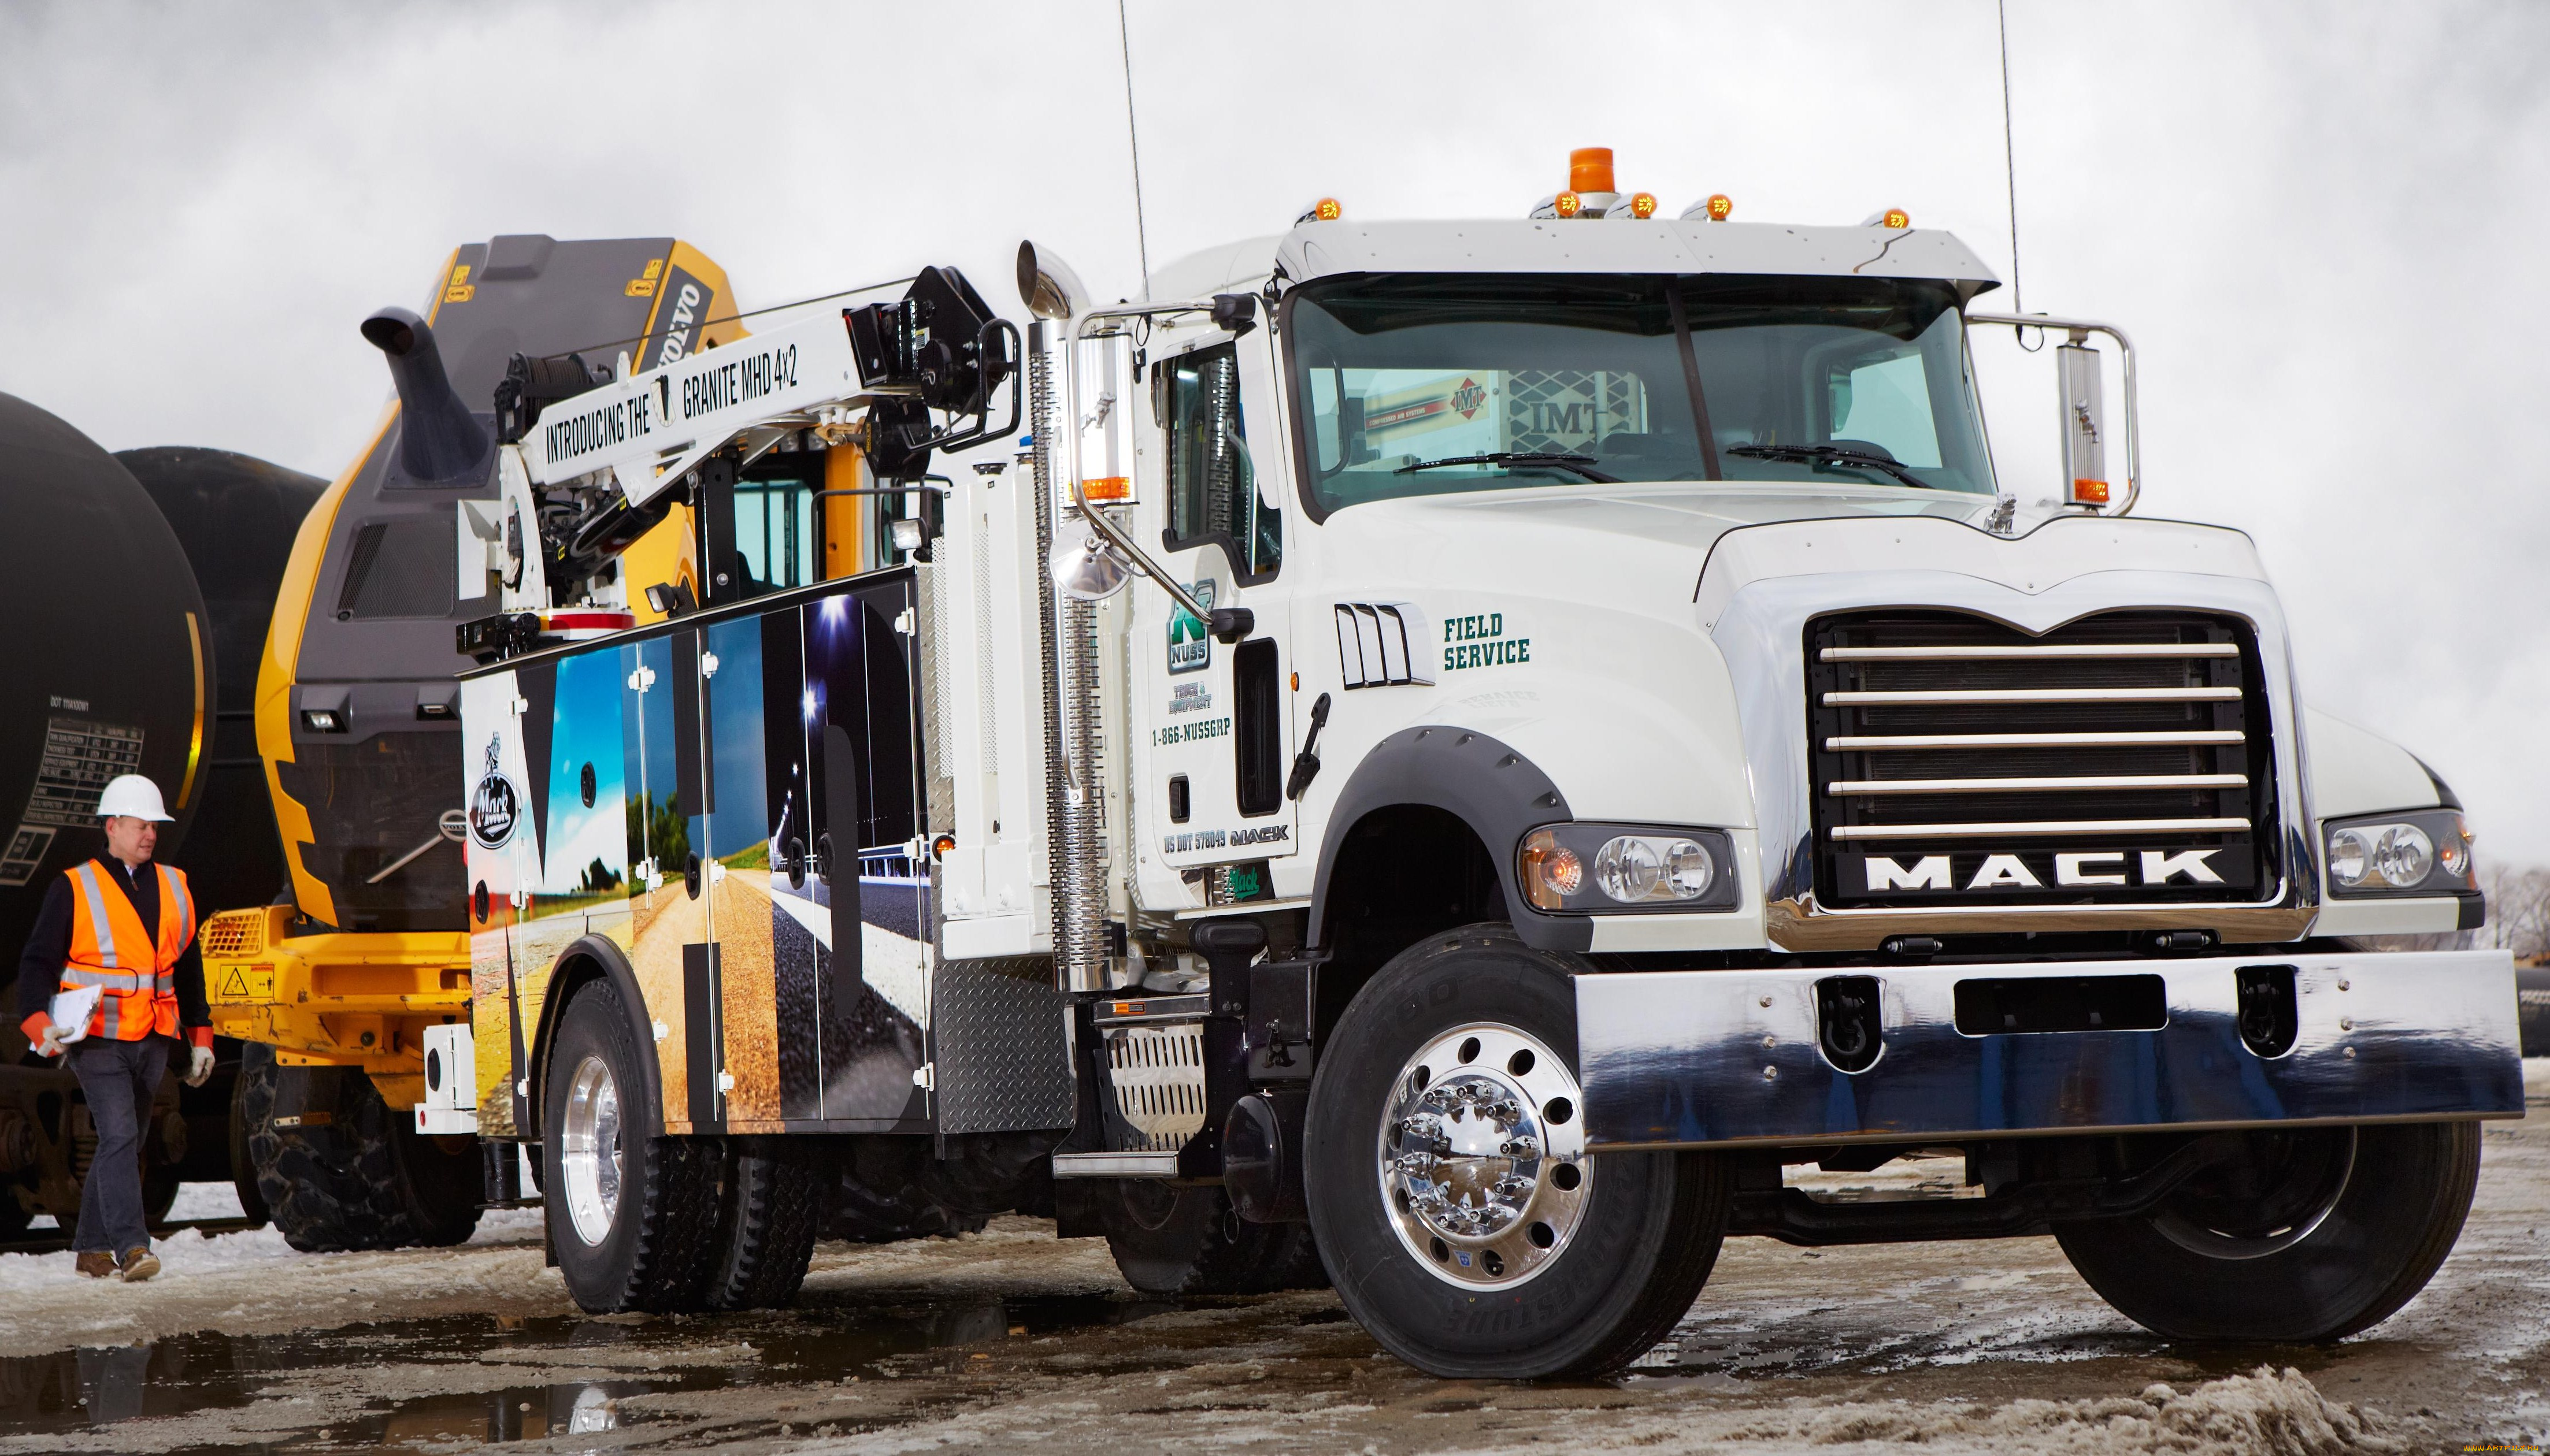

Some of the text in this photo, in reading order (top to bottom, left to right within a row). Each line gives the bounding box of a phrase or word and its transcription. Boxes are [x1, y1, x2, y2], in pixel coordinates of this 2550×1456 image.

[546, 344, 798, 464] INTRODUCING THE GRANITE MHD 4x2
[1454, 384, 1482, 412] IMT
[1369, 415, 1396, 426] COMPRESSED
[1406, 407, 1426, 418] SYSTEMS
[1444, 613, 1502, 642] FIELD
[1172, 642, 1205, 664] NUSS
[1444, 638, 1530, 671] SERVICE
[50, 696, 62, 708] DOT
[1168, 694, 1212, 715] EQUIPMENT
[1173, 682, 1198, 700] TRUCK
[1152, 717, 1230, 746] 1-866-NUSSGRP
[476, 785, 510, 832] Mack
[1164, 829, 1226, 855] US DOT 578049
[1230, 824, 1289, 846] MACK
[1865, 849, 2226, 892] MACK
